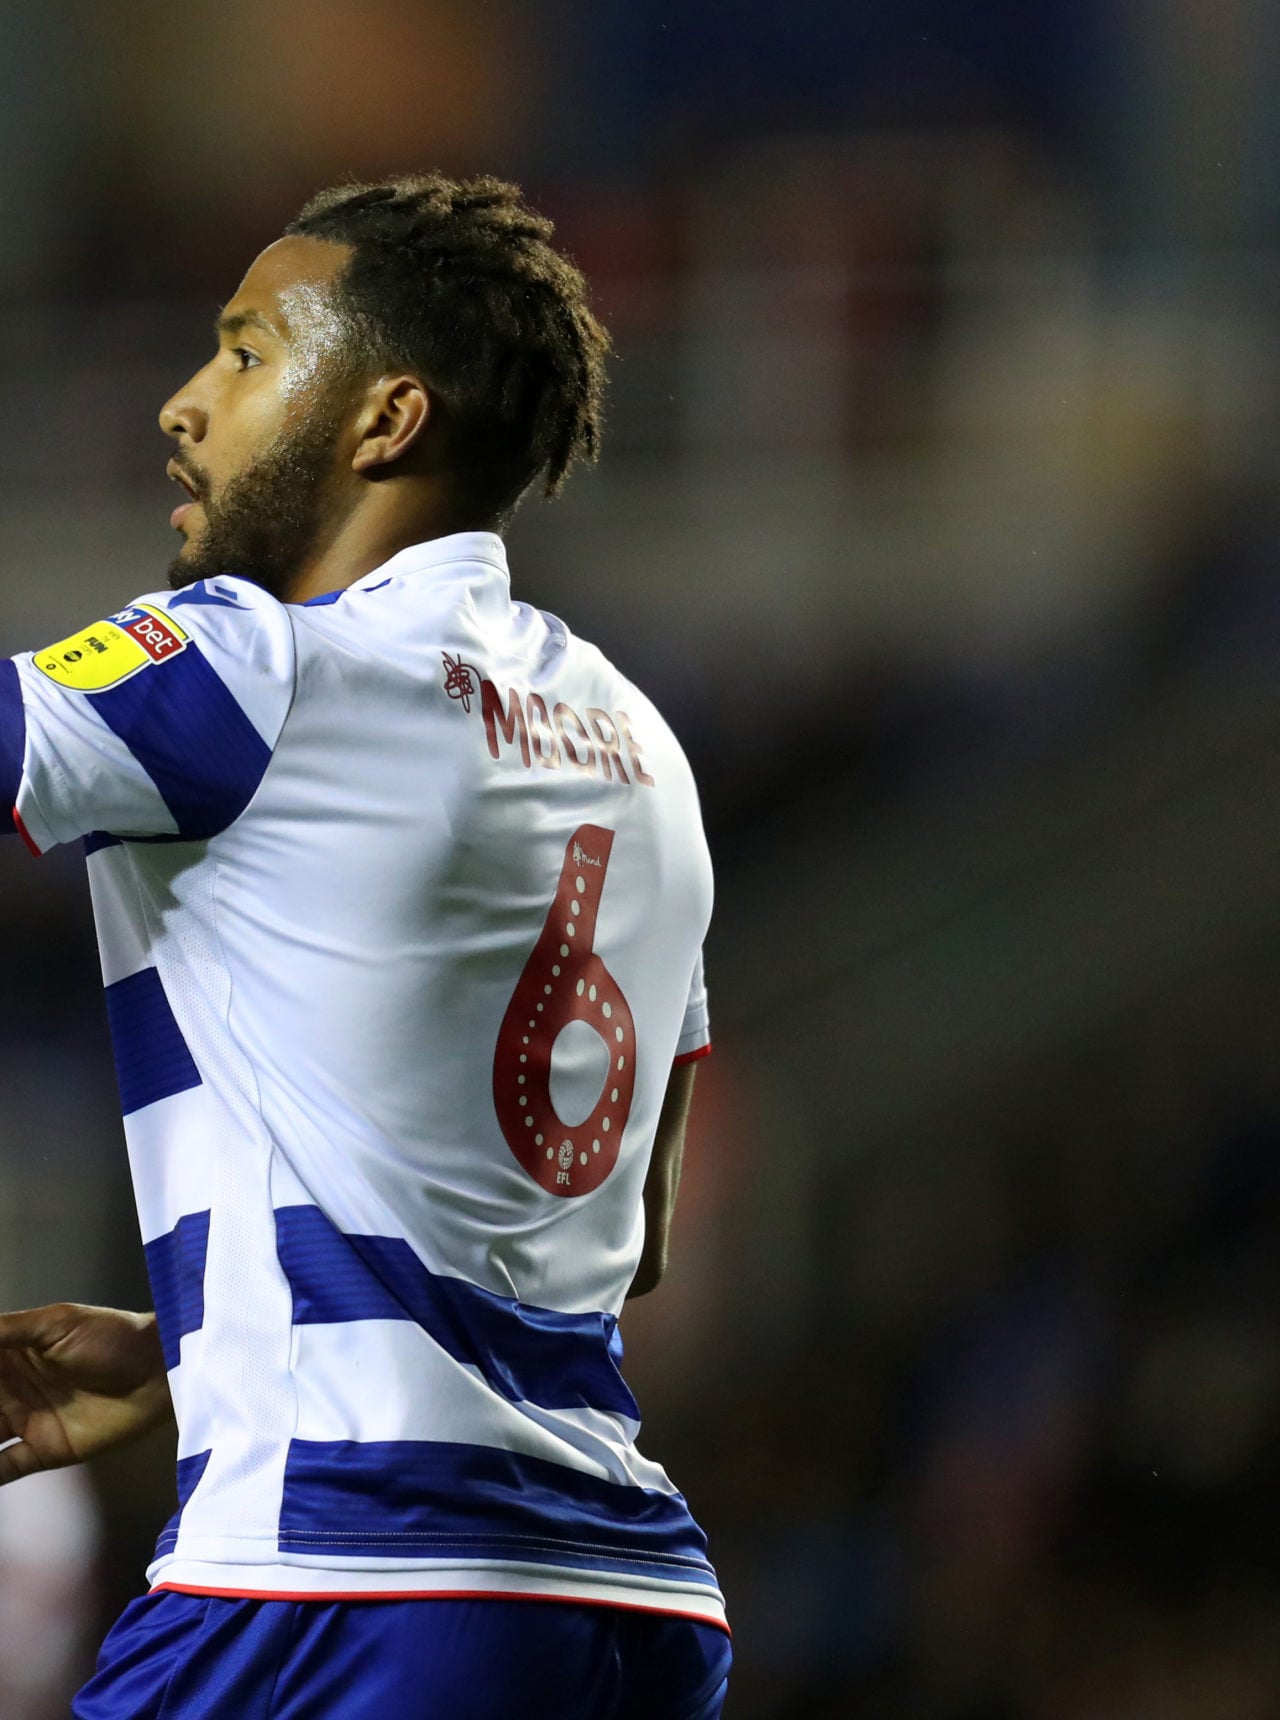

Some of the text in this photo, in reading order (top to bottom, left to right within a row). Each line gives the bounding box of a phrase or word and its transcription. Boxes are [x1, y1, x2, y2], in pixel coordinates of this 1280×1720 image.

[84, 636, 108, 654] FUN
[133, 618, 173, 654] bet
[480, 679, 656, 787] MOORE
[493, 823, 637, 1198] 6
[556, 1171, 571, 1186] EFL
